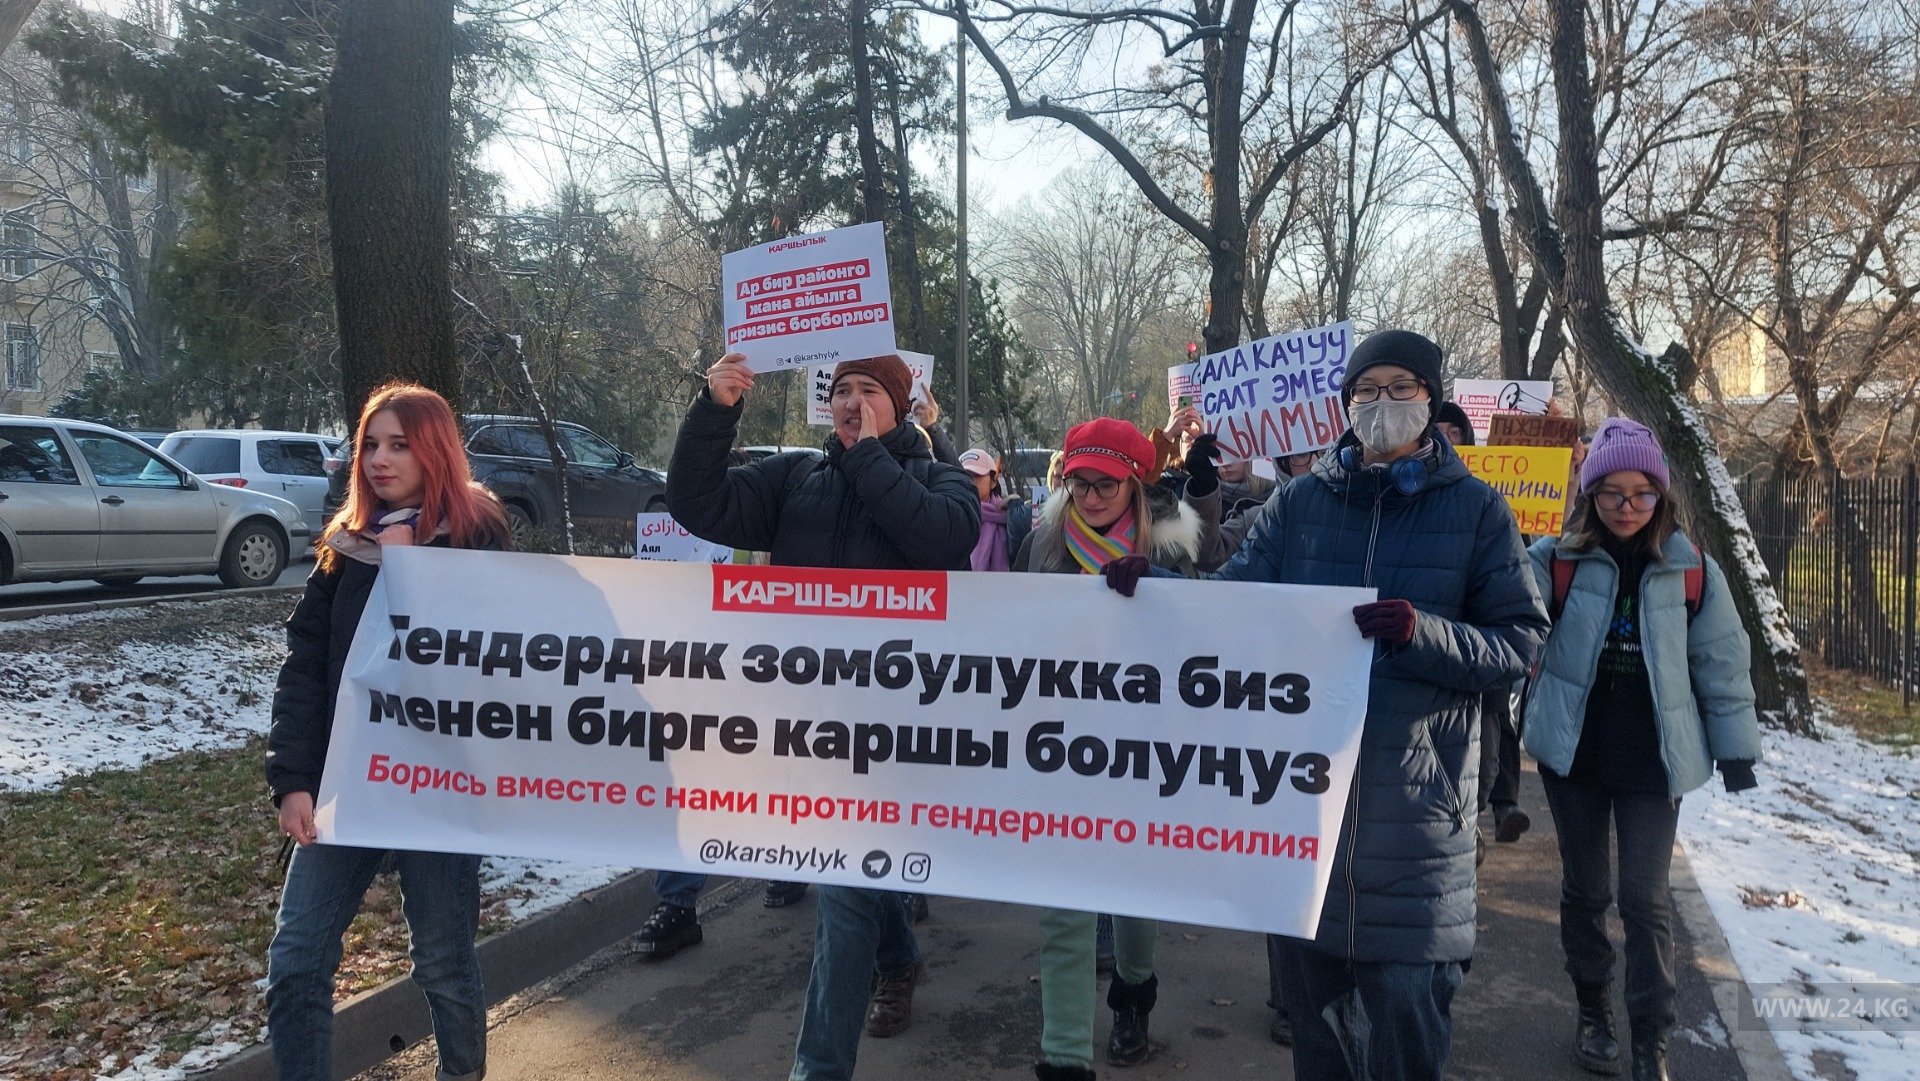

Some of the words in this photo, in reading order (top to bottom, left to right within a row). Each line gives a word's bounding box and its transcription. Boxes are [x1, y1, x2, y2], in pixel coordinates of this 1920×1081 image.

[768, 236, 827, 254] КАРШЫЛЫК
[739, 280, 760, 297] Ар
[762, 273, 792, 292] бир
[795, 263, 866, 288] районго
[749, 298, 791, 316] жана
[795, 287, 857, 308] айылга
[729, 321, 787, 343] кризис
[789, 306, 885, 334] борборлор
[793, 350, 841, 365] @karshylyk
[1202, 348, 1249, 385] АЛА
[1252, 328, 1347, 372] КАЧУУ
[816, 369, 833, 381] Ая
[1203, 377, 1260, 415] САЛТ
[1271, 365, 1346, 404] ЭМЕС
[1461, 395, 1495, 405] Долой
[640, 544, 661, 553] Аял
[723, 579, 936, 612] КАРШЫЛЫК
[388, 614, 729, 686] Гендердик
[742, 638, 1162, 710] зомбулукка
[1178, 655, 1311, 714] биз
[368, 688, 553, 741] менен
[567, 696, 758, 762] бирге
[773, 717, 1009, 775] каршы
[1025, 720, 1332, 805] болуңуз
[367, 753, 487, 797] Борись
[496, 774, 627, 805] вместе
[635, 784, 656, 807] с
[664, 787, 759, 815] нами
[767, 792, 901, 825] против
[910, 800, 1137, 844] гендерного
[1147, 821, 1319, 861] насилия
[699, 838, 848, 873] @karshylyk
